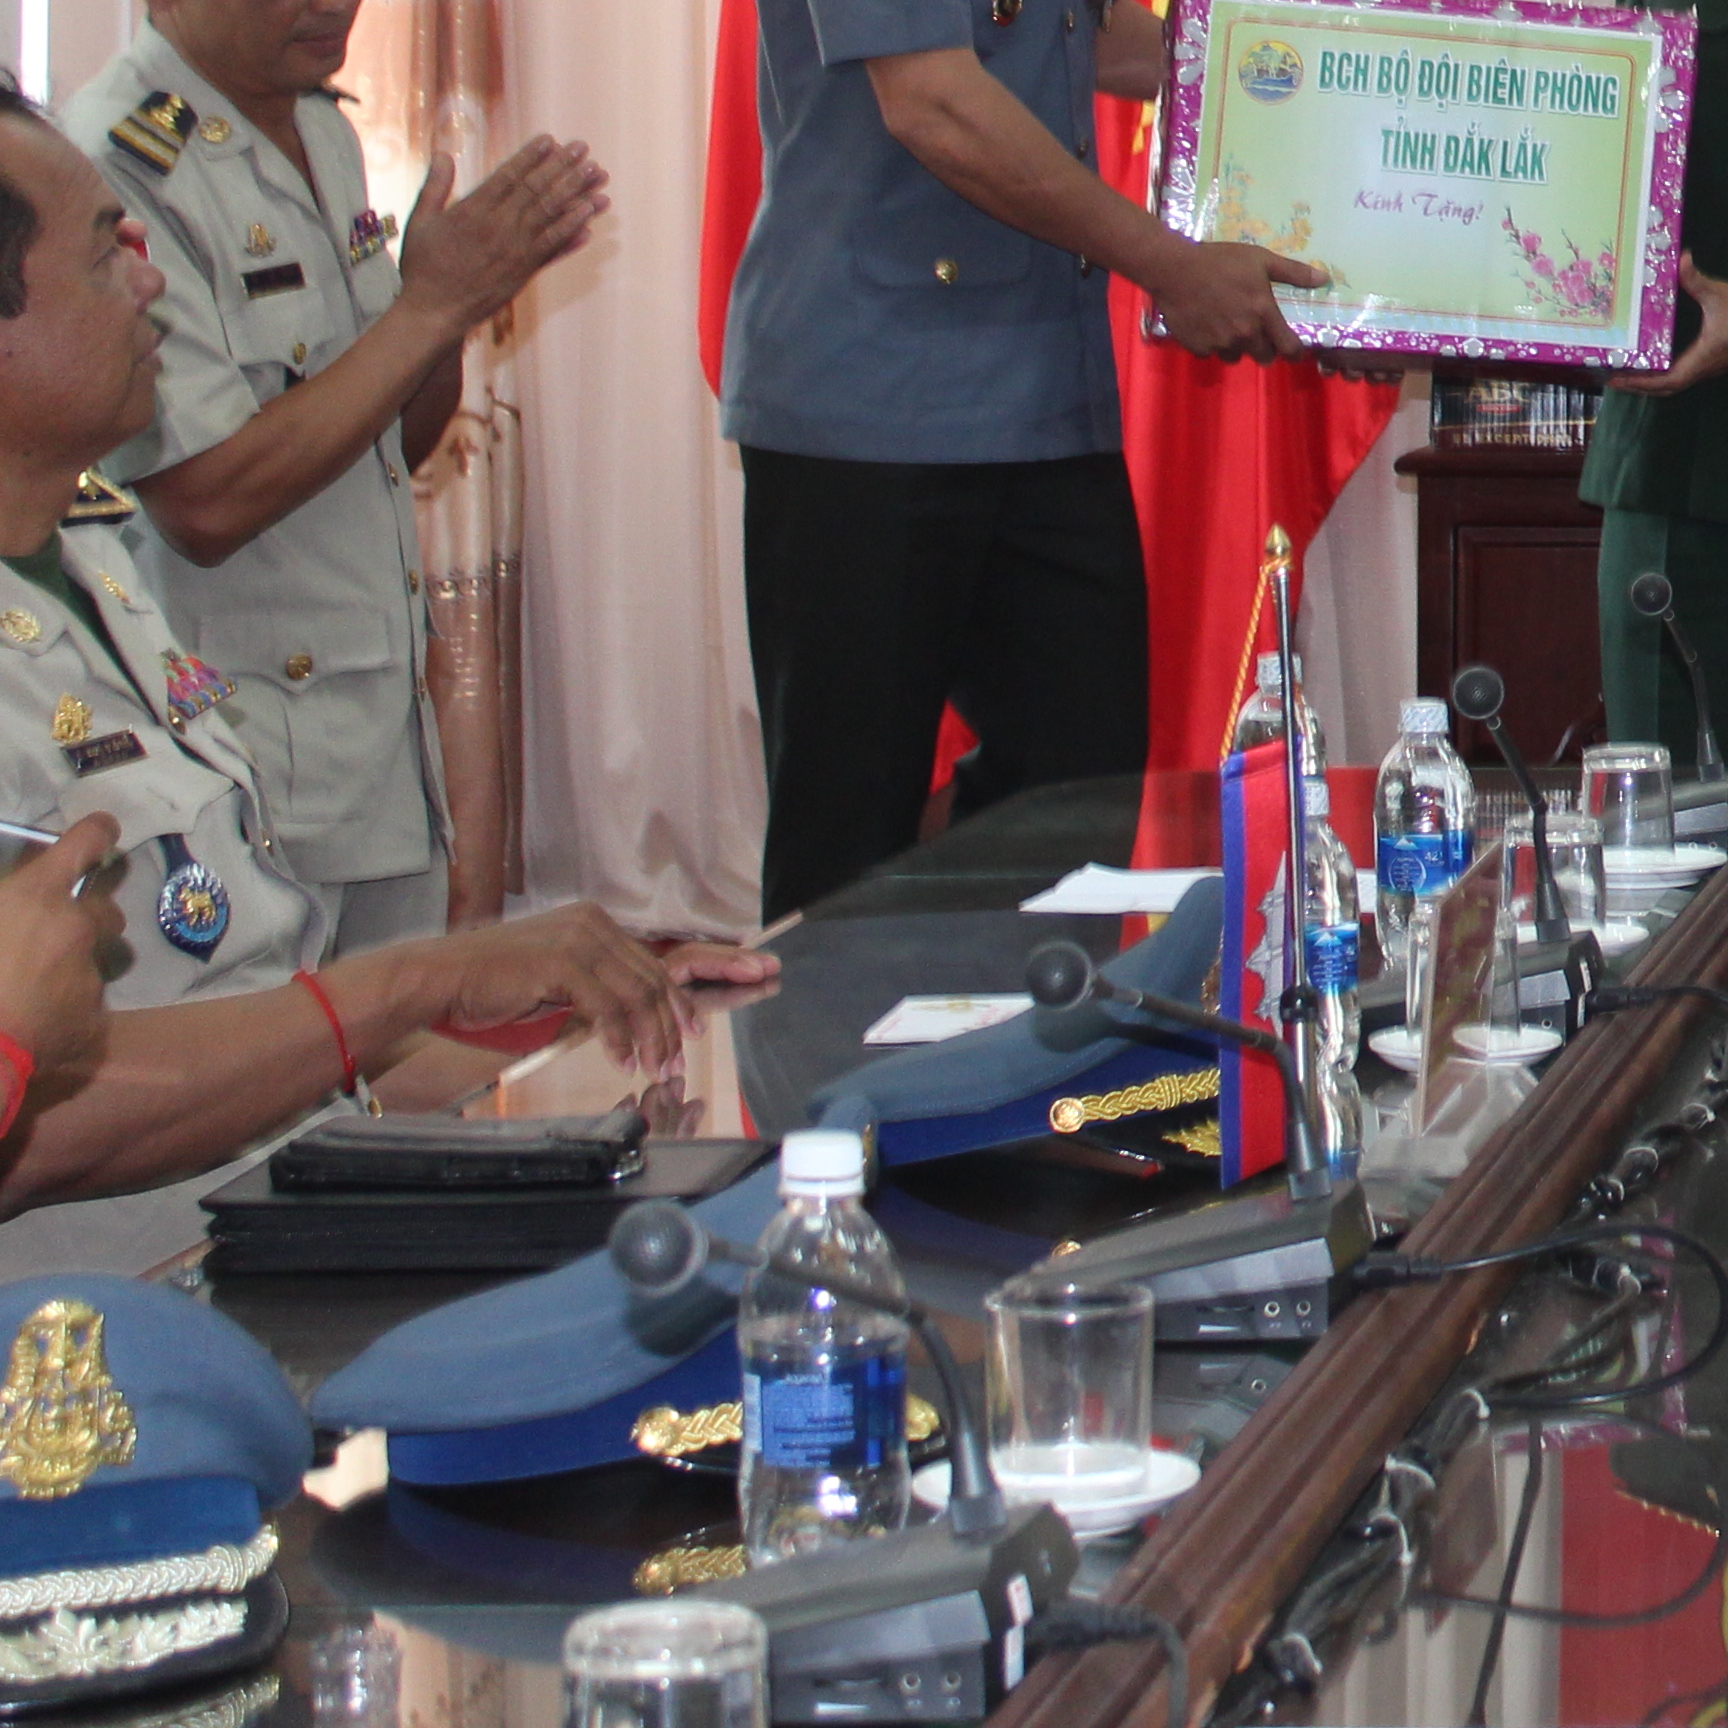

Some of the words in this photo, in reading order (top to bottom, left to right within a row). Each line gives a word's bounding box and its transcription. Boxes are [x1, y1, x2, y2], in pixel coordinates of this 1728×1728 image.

[1319, 50, 1371, 93] BCH
[1377, 49, 1410, 105] BỘ
[1417, 53, 1460, 110] ĐỘI
[1466, 58, 1526, 107] BIÊN
[1532, 64, 1618, 116] PHÒNG
[1380, 116, 1438, 173] TỈNH
[1443, 122, 1495, 178] ĐẮK
[1501, 127, 1548, 182] LẮK
